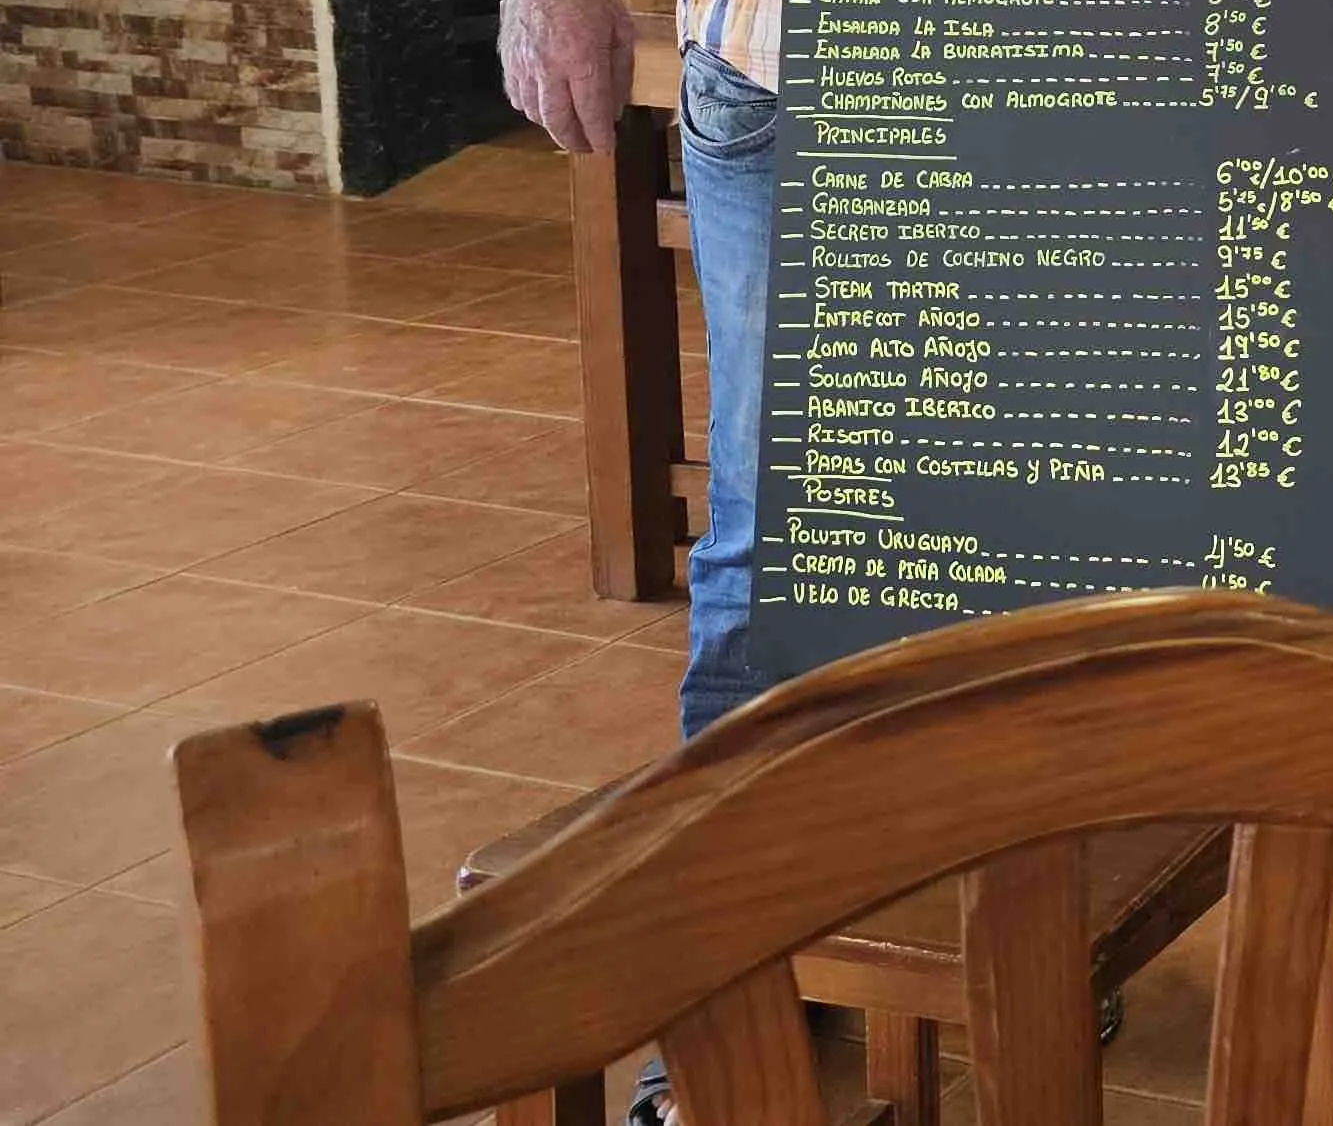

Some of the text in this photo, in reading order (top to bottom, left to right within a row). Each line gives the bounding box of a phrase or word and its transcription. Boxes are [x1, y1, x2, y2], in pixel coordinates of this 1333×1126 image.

[817, 12, 900, 35] ENSALADA
[914, 17, 936, 36] LA
[943, 19, 995, 38] ISLA
[814, 39, 900, 60] ENSALADA
[911, 41, 932, 59] LA
[820, 65, 884, 87] HUEVOS
[892, 67, 946, 86] ROTOS
[821, 91, 948, 112] CHAMPIÑONES
[961, 93, 995, 109] CON
[1006, 90, 1118, 109] ALMOGROTE
[814, 120, 947, 145] PRINCIPALES
[812, 165, 868, 190] CARNE
[881, 171, 905, 189] DE
[916, 170, 973, 189] CABRA
[812, 192, 930, 216] GARBANZADA
[810, 220, 888, 241] SECRETO
[898, 225, 980, 240] IBERICO
[812, 245, 892, 267] ROLLITOS
[907, 251, 929, 266] DE
[943, 249, 1025, 266] COCHINO
[1037, 249, 1105, 267] NEGRO
[815, 276, 872, 299] STEAK
[886, 281, 960, 299] TARTAR
[814, 302, 905, 328] ENTRECOT
[918, 307, 980, 330] AÑOJO
[807, 334, 858, 359] LOMO
[870, 338, 915, 358] ALTO
[924, 336, 991, 362] AÑOJO
[809, 365, 906, 388] SOLOMILLO
[920, 367, 988, 393] AÑOJO
[904, 397, 996, 420] IBERICO
[807, 423, 894, 444] RISOTTO
[805, 449, 866, 474] PAPAS
[874, 457, 906, 474] CON
[916, 455, 1018, 478] COSTILLAS
[1049, 458, 1105, 481] PIÑA
[803, 476, 895, 508] POSTRES
[878, 529, 978, 555] URUGUAYO
[792, 553, 856, 576] CREMA
[865, 557, 887, 578] DE
[898, 560, 939, 581] PIÑA
[948, 561, 1008, 585] COLADA
[848, 588, 870, 605] DE
[881, 588, 959, 611] GRECIA
